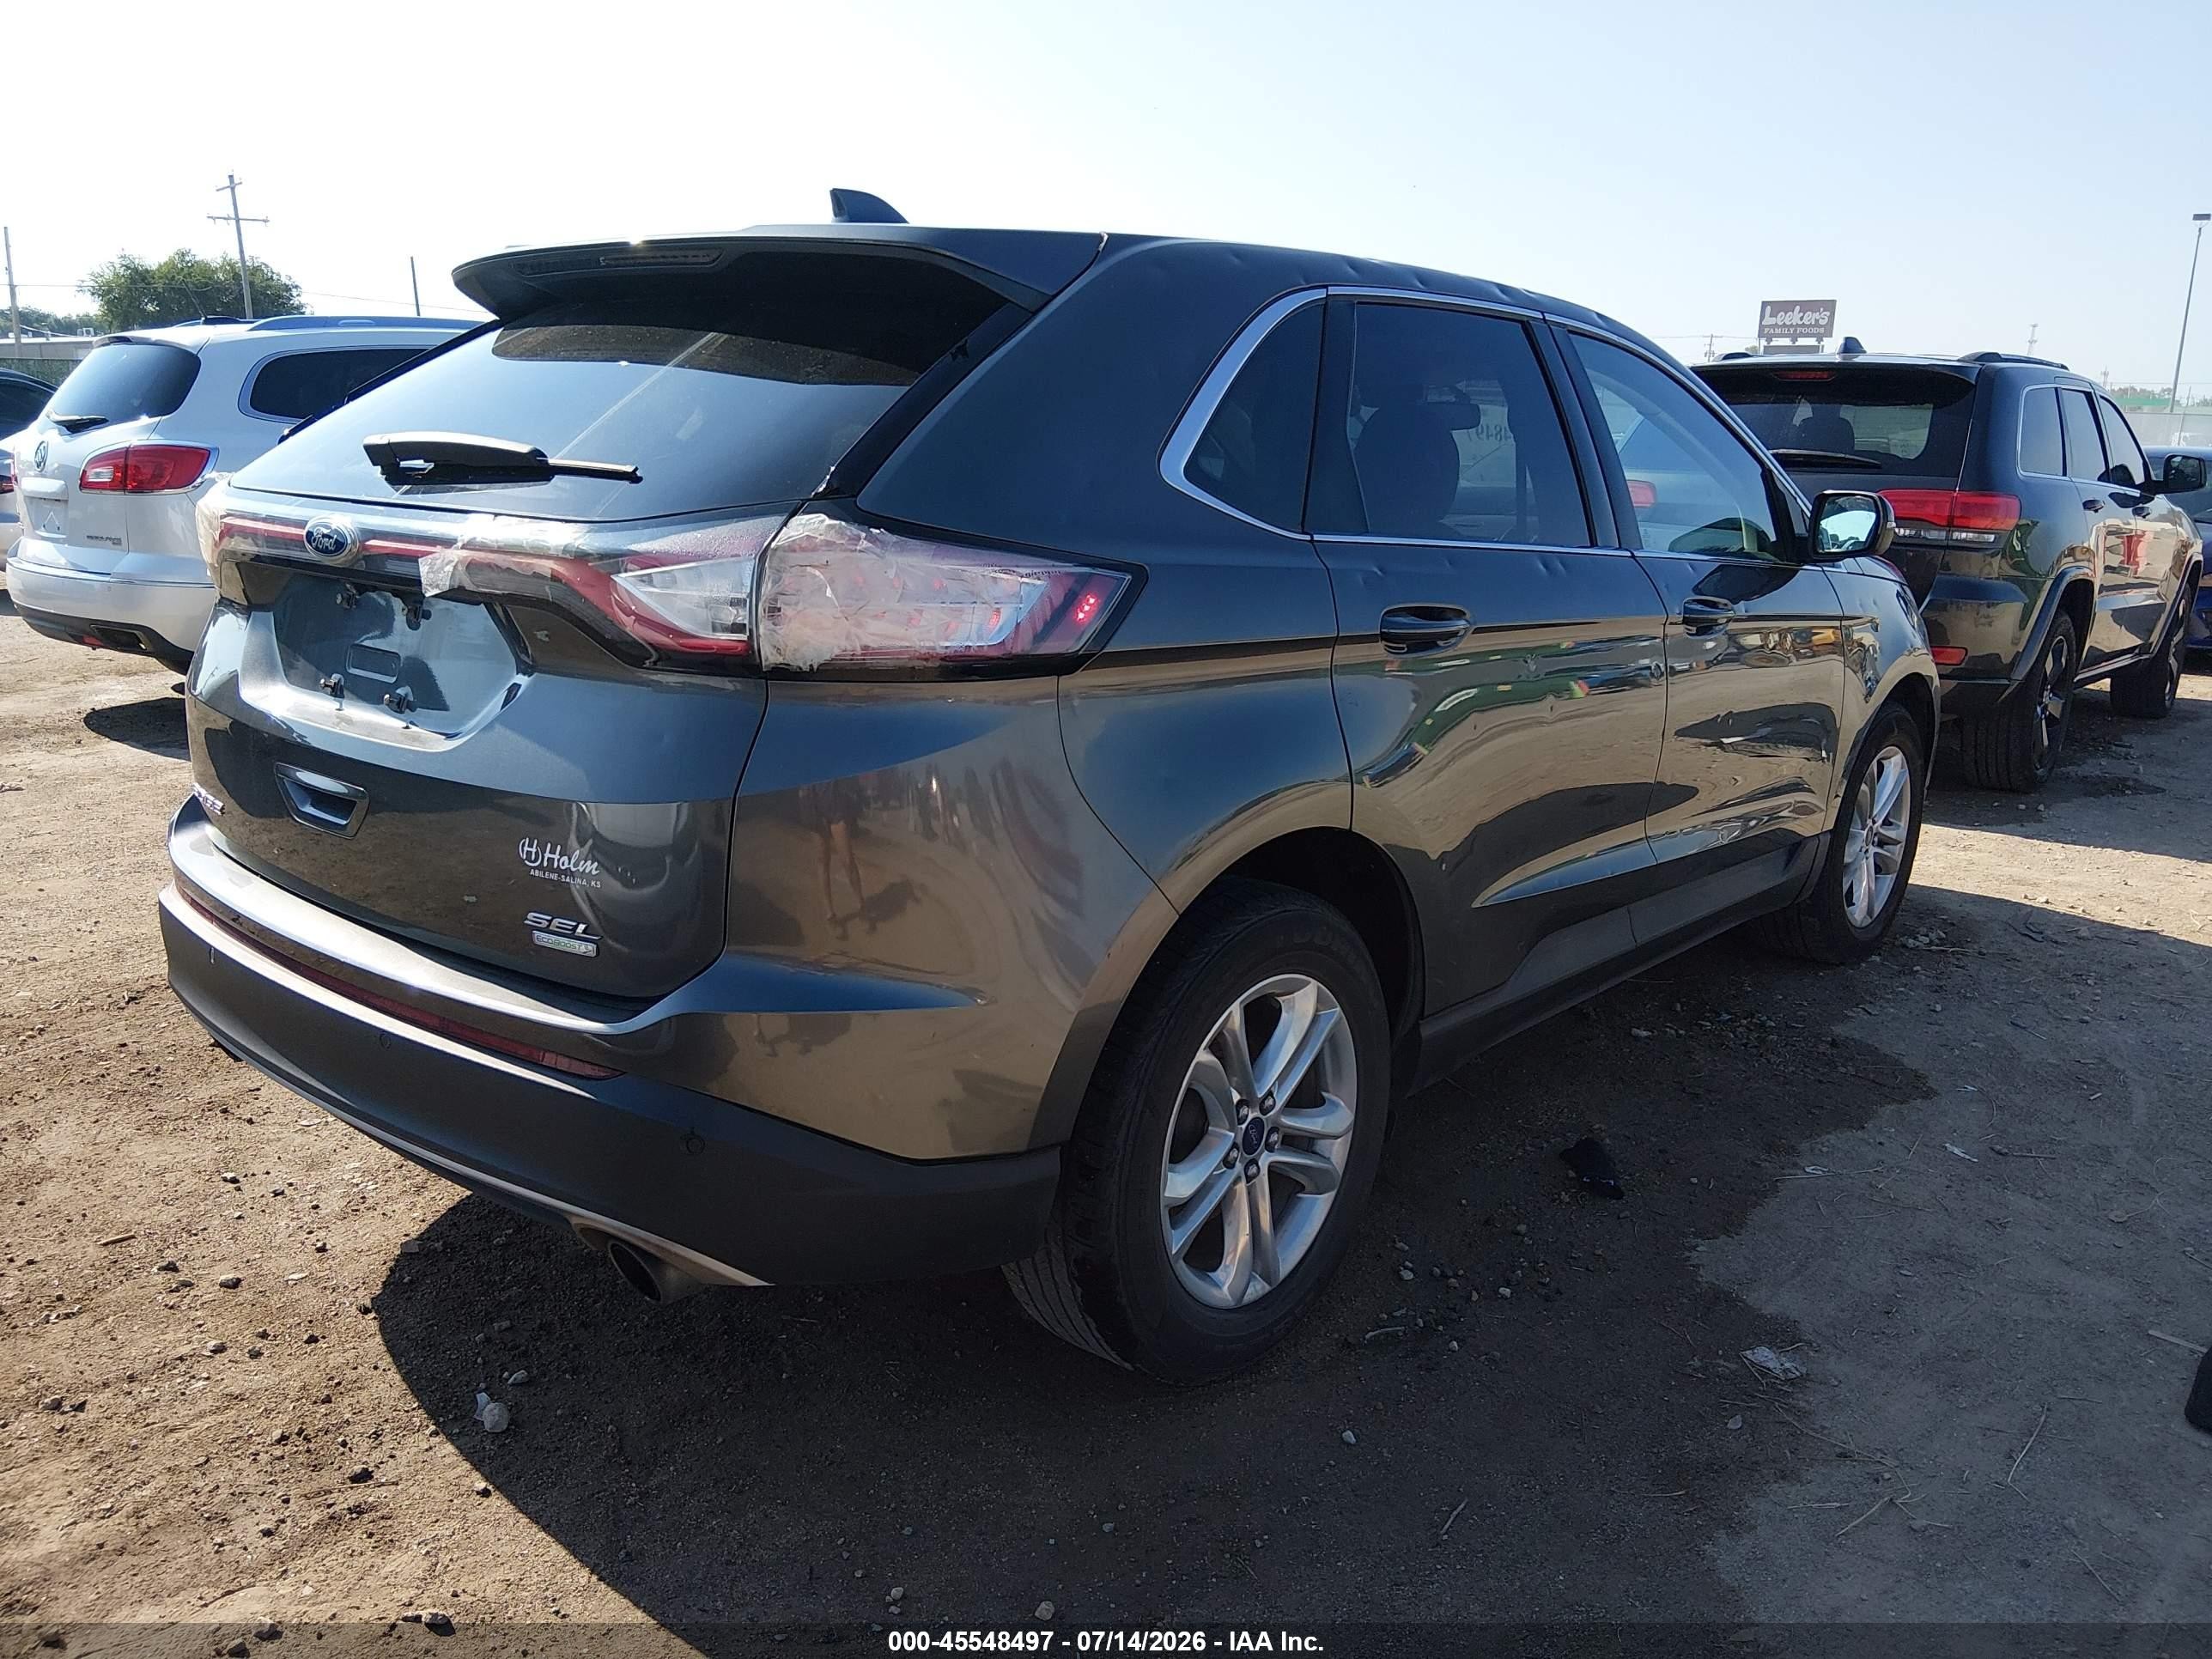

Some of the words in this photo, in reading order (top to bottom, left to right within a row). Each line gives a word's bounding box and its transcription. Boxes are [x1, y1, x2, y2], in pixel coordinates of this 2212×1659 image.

[1762, 306, 1830, 325] Leeker's
[311, 526, 337, 550] Ford
[544, 842, 600, 876] Holm
[524, 912, 603, 940] SEL
